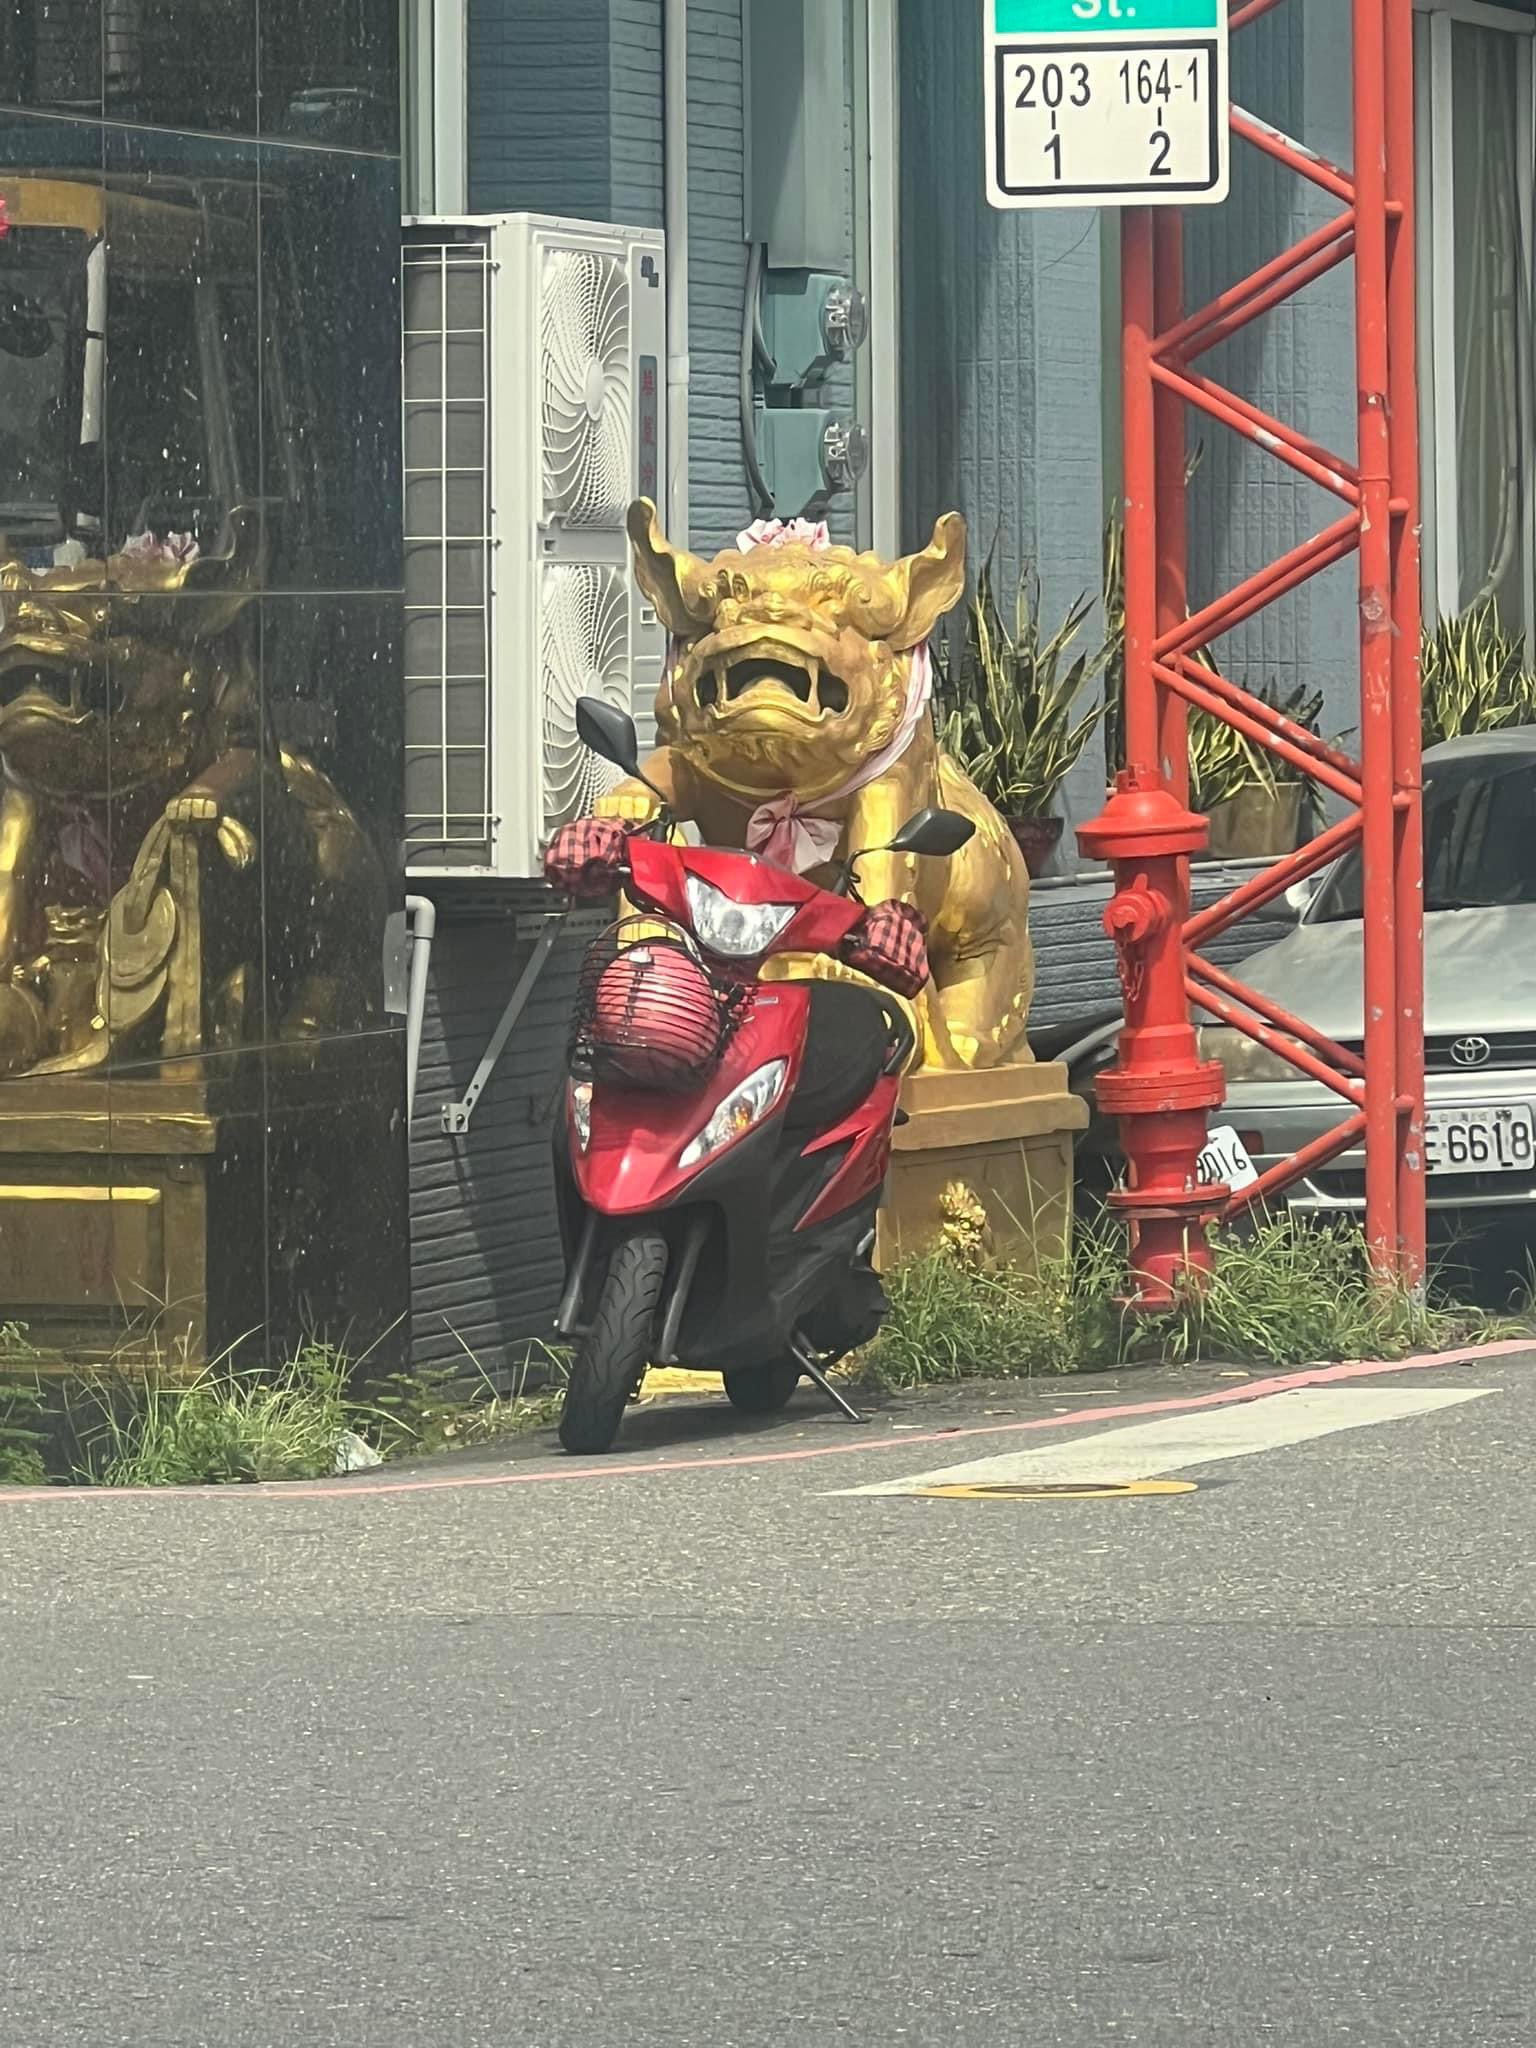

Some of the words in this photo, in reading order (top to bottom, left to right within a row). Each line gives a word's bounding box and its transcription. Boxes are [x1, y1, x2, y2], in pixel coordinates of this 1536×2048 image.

[1014, 62, 1091, 108] 203
[1119, 57, 1198, 104] 164-1
[1043, 134, 1061, 180] 1
[1149, 131, 1172, 176] 2
